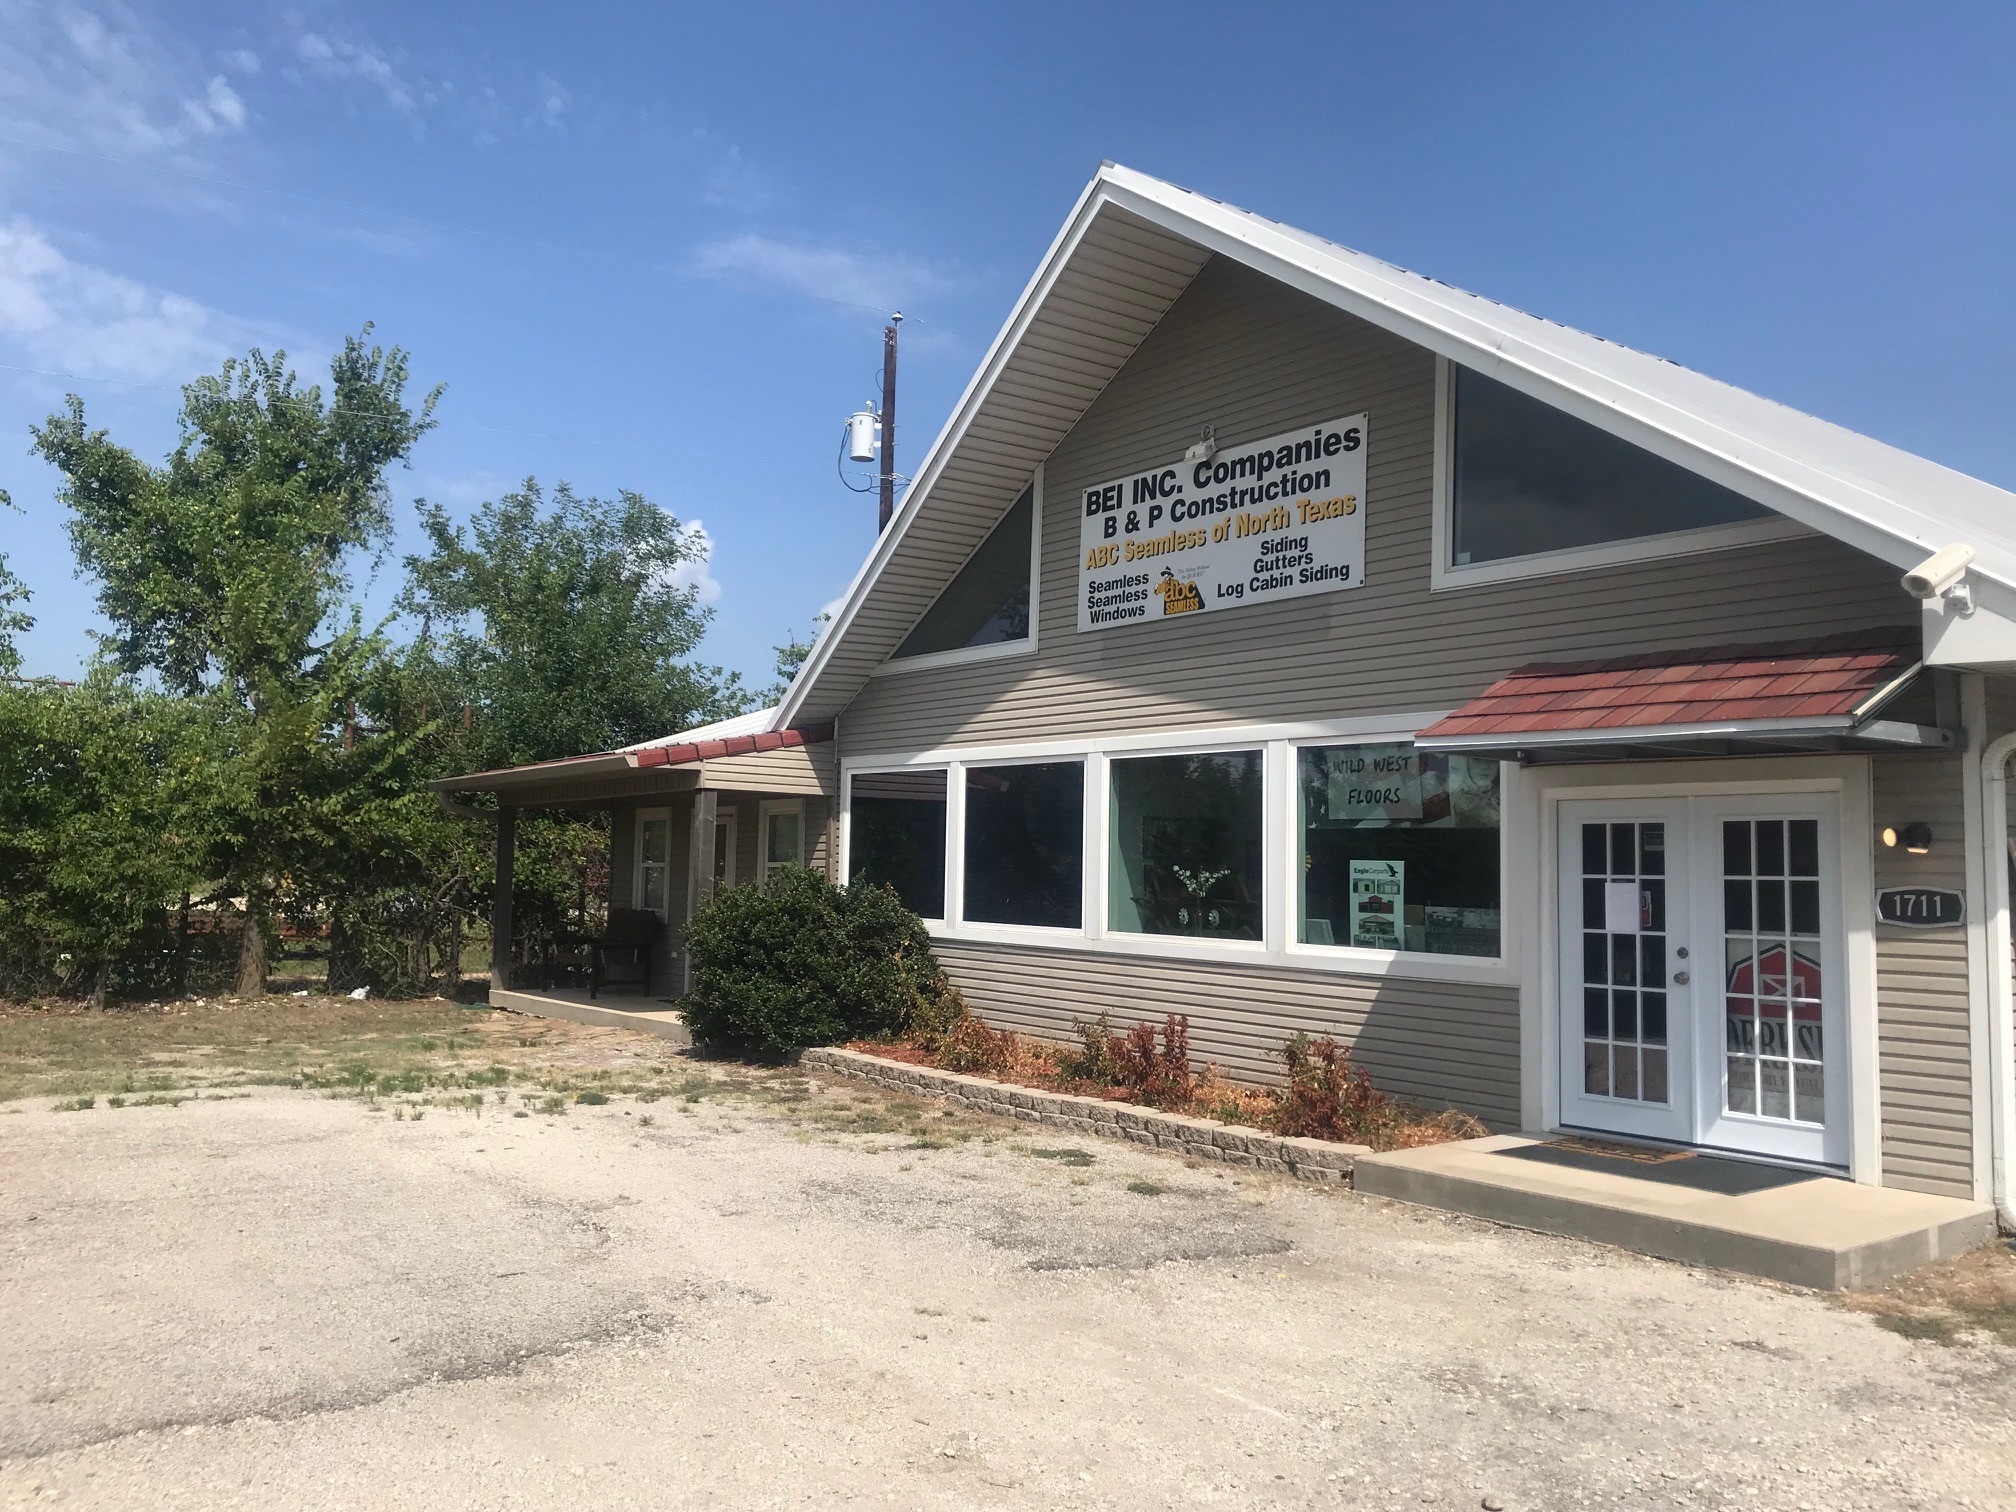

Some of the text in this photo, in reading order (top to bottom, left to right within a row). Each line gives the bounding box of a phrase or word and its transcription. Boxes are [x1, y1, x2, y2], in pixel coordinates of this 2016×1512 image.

[1086, 427, 1361, 517] BEI INC. Companies
[1103, 468, 1331, 539] B & P Construction
[1085, 491, 1357, 570] ABC Seamless of North Texas
[1260, 536, 1308, 556] Siding
[1253, 552, 1314, 574] Gutters
[1088, 573, 1149, 594] Seamless
[1165, 578, 1197, 602] abc
[1217, 564, 1350, 598] Log Cabin Siding
[1087, 588, 1148, 609] Seamless
[1165, 597, 1199, 615] SEAMLESS
[1089, 604, 1145, 624] Windows
[1333, 755, 1412, 774] WILD WEST
[1348, 787, 1400, 805] FLOORS
[1893, 894, 1941, 916] 1711
